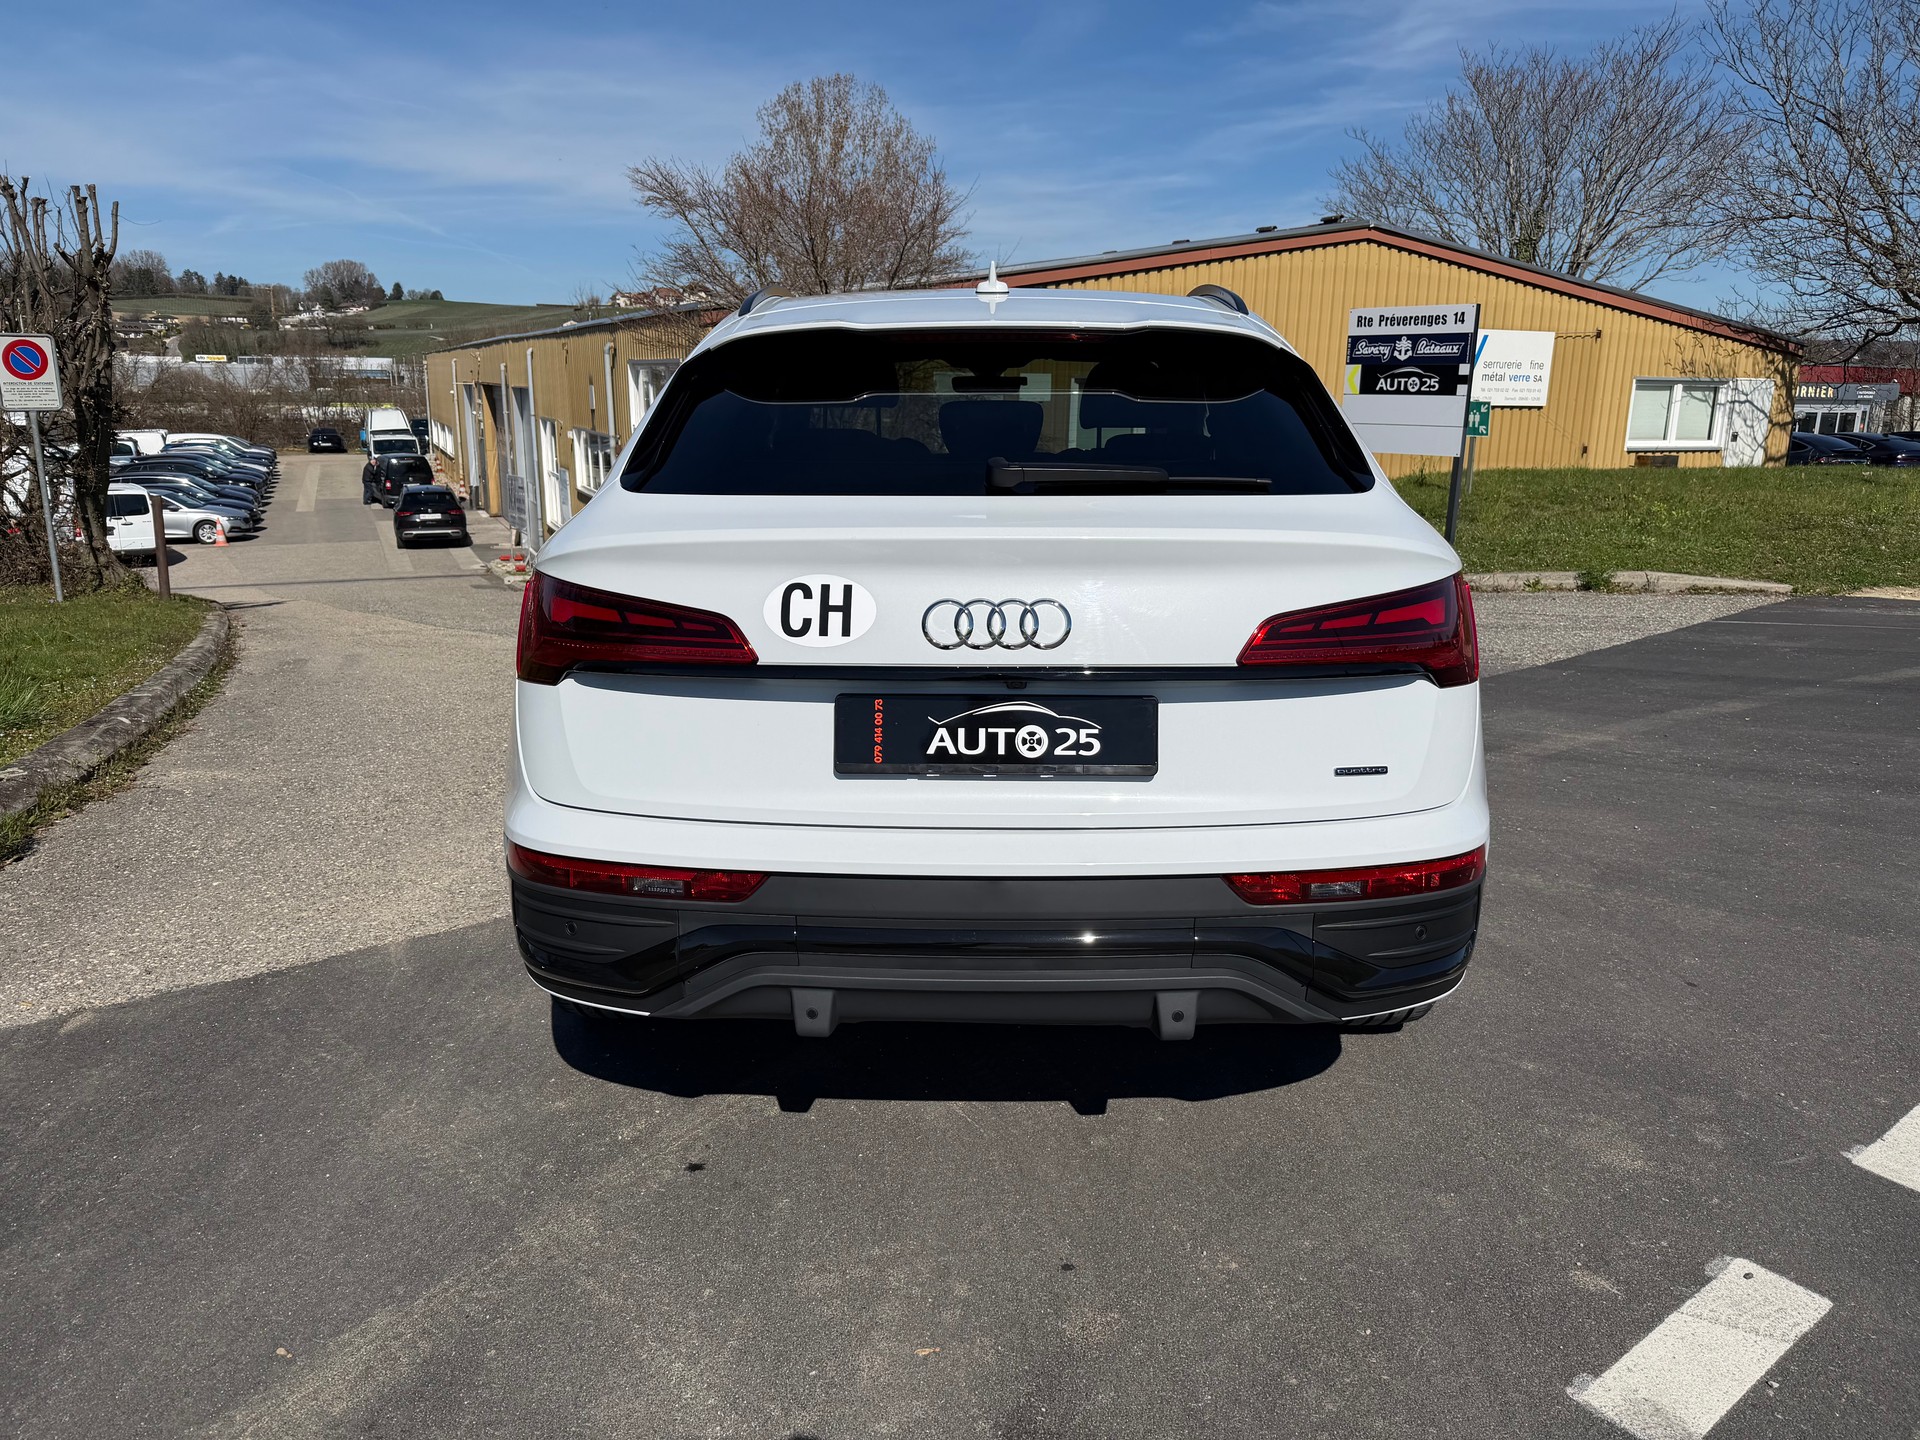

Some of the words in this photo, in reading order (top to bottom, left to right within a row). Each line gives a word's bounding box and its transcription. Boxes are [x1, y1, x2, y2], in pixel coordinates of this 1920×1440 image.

[1356, 315, 1374, 328] Rte
[1378, 313, 1448, 328] Préverenges
[1453, 311, 1466, 325] 14
[1355, 340, 1391, 359] Savary
[1416, 339, 1459, 354] Bateaux
[1482, 360, 1522, 370] serrurerie
[1529, 360, 1545, 371] fine
[1481, 371, 1506, 382] métal
[1508, 374, 1531, 382] verre
[1532, 374, 1543, 382] SA
[780, 582, 853, 638] CH
[874, 698, 883, 711] 73
[874, 712, 883, 726] 00
[873, 727, 883, 744] 414
[873, 745, 883, 763] 079
[1336, 767, 1387, 775] quattro
